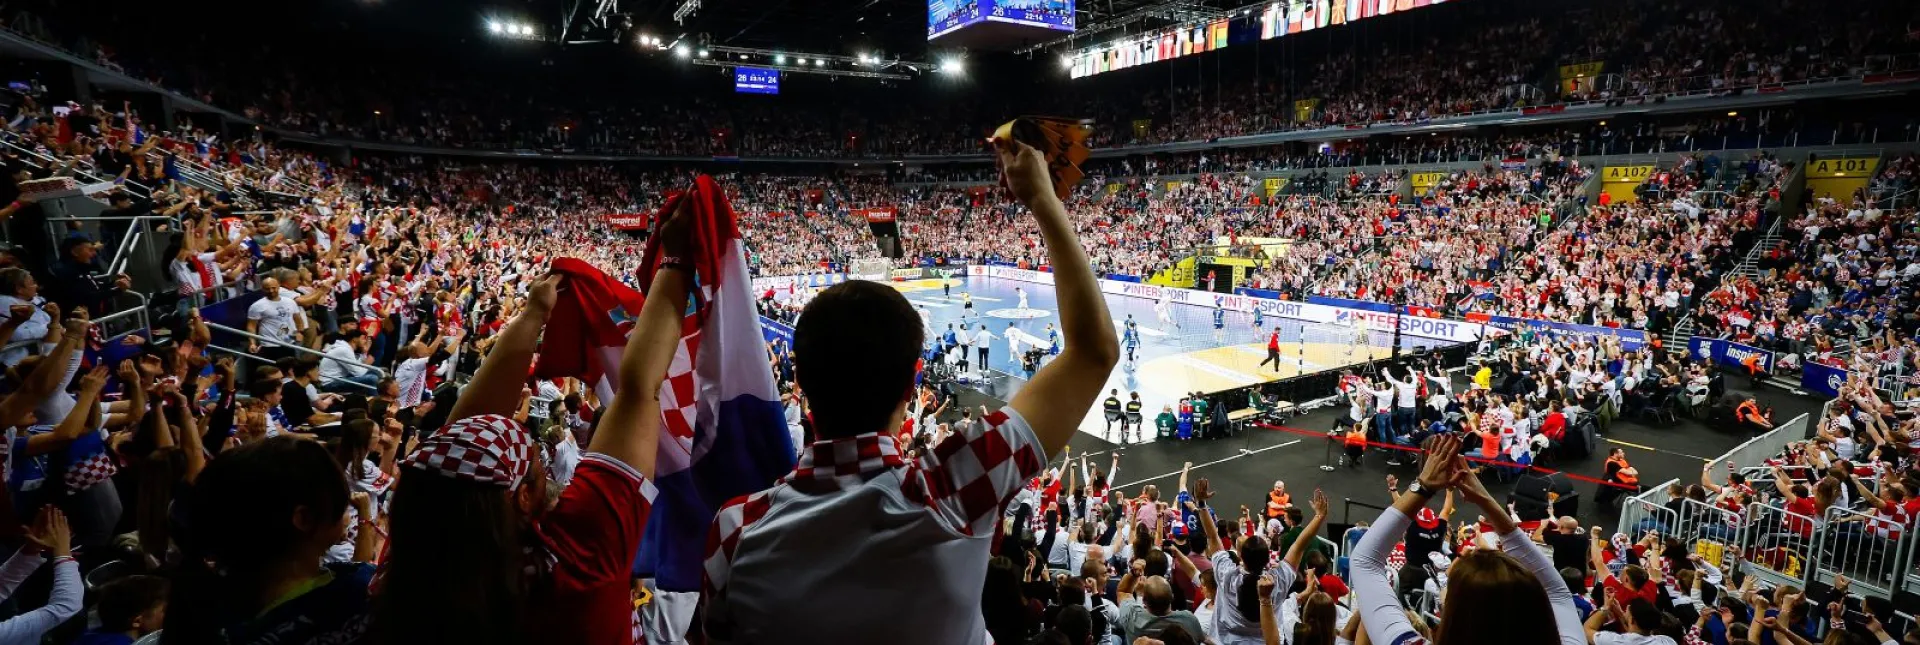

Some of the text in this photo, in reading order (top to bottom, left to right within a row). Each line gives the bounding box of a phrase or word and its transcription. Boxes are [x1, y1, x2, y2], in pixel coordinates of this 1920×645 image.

[992, 6, 1004, 17] 26
[1061, 17, 1072, 25] 24
[1611, 167, 1647, 177] A 102
[1817, 159, 1867, 172] A 101
[1417, 174, 1424, 182] A
[1726, 344, 1768, 366] inspid
